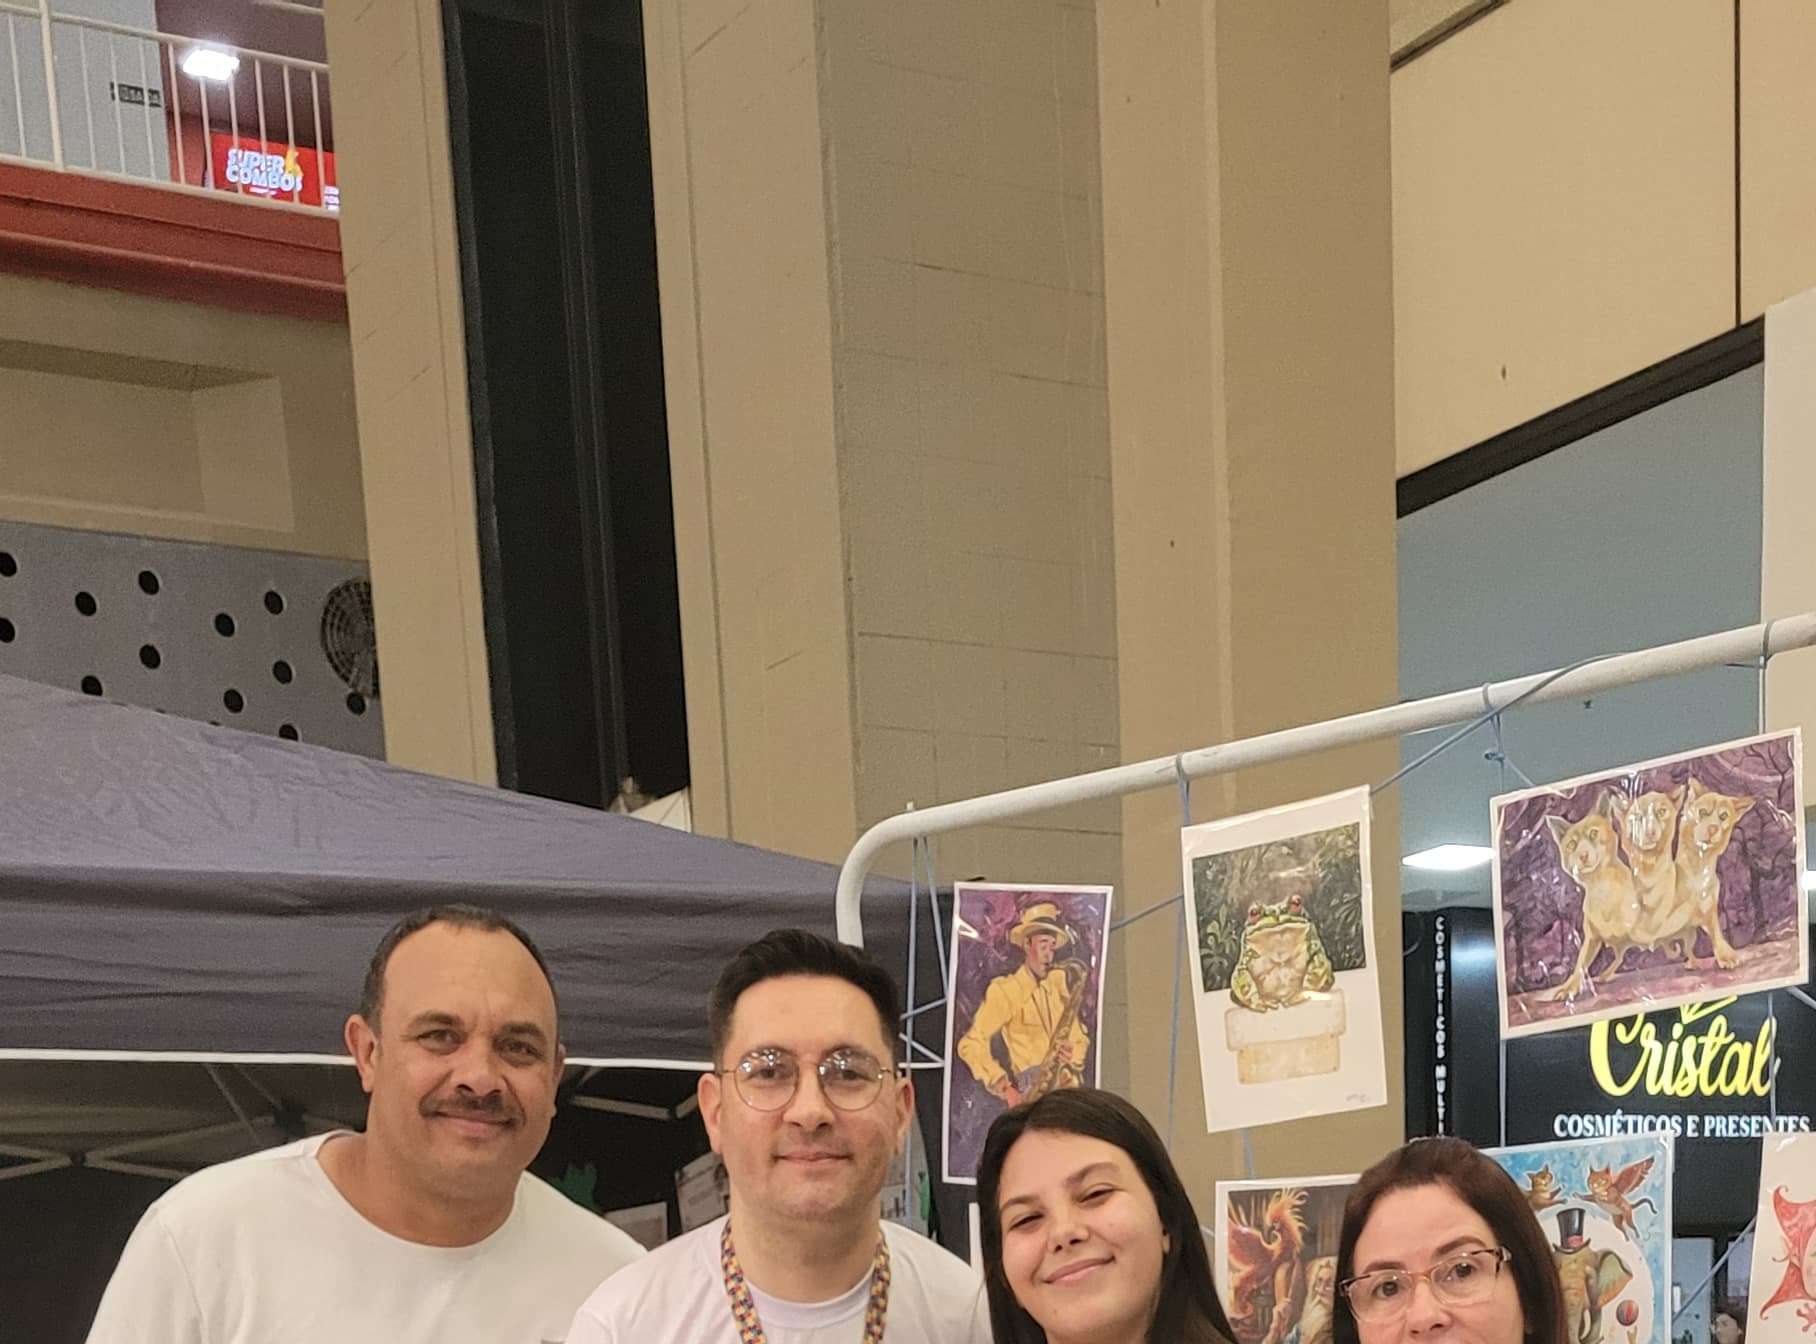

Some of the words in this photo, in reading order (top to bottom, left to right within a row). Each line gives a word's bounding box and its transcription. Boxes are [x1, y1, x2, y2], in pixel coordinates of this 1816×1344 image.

[228, 148, 285, 171] SUPER
[1435, 916, 1446, 1059] COSMETICOS
[1590, 1012, 1781, 1097] Cristal
[1435, 1064, 1447, 1138] MULTI
[1553, 1109, 1682, 1137] COSMÉTICOS
[1687, 1115, 1699, 1137] E
[1704, 1115, 1811, 1138] PRESENTES
